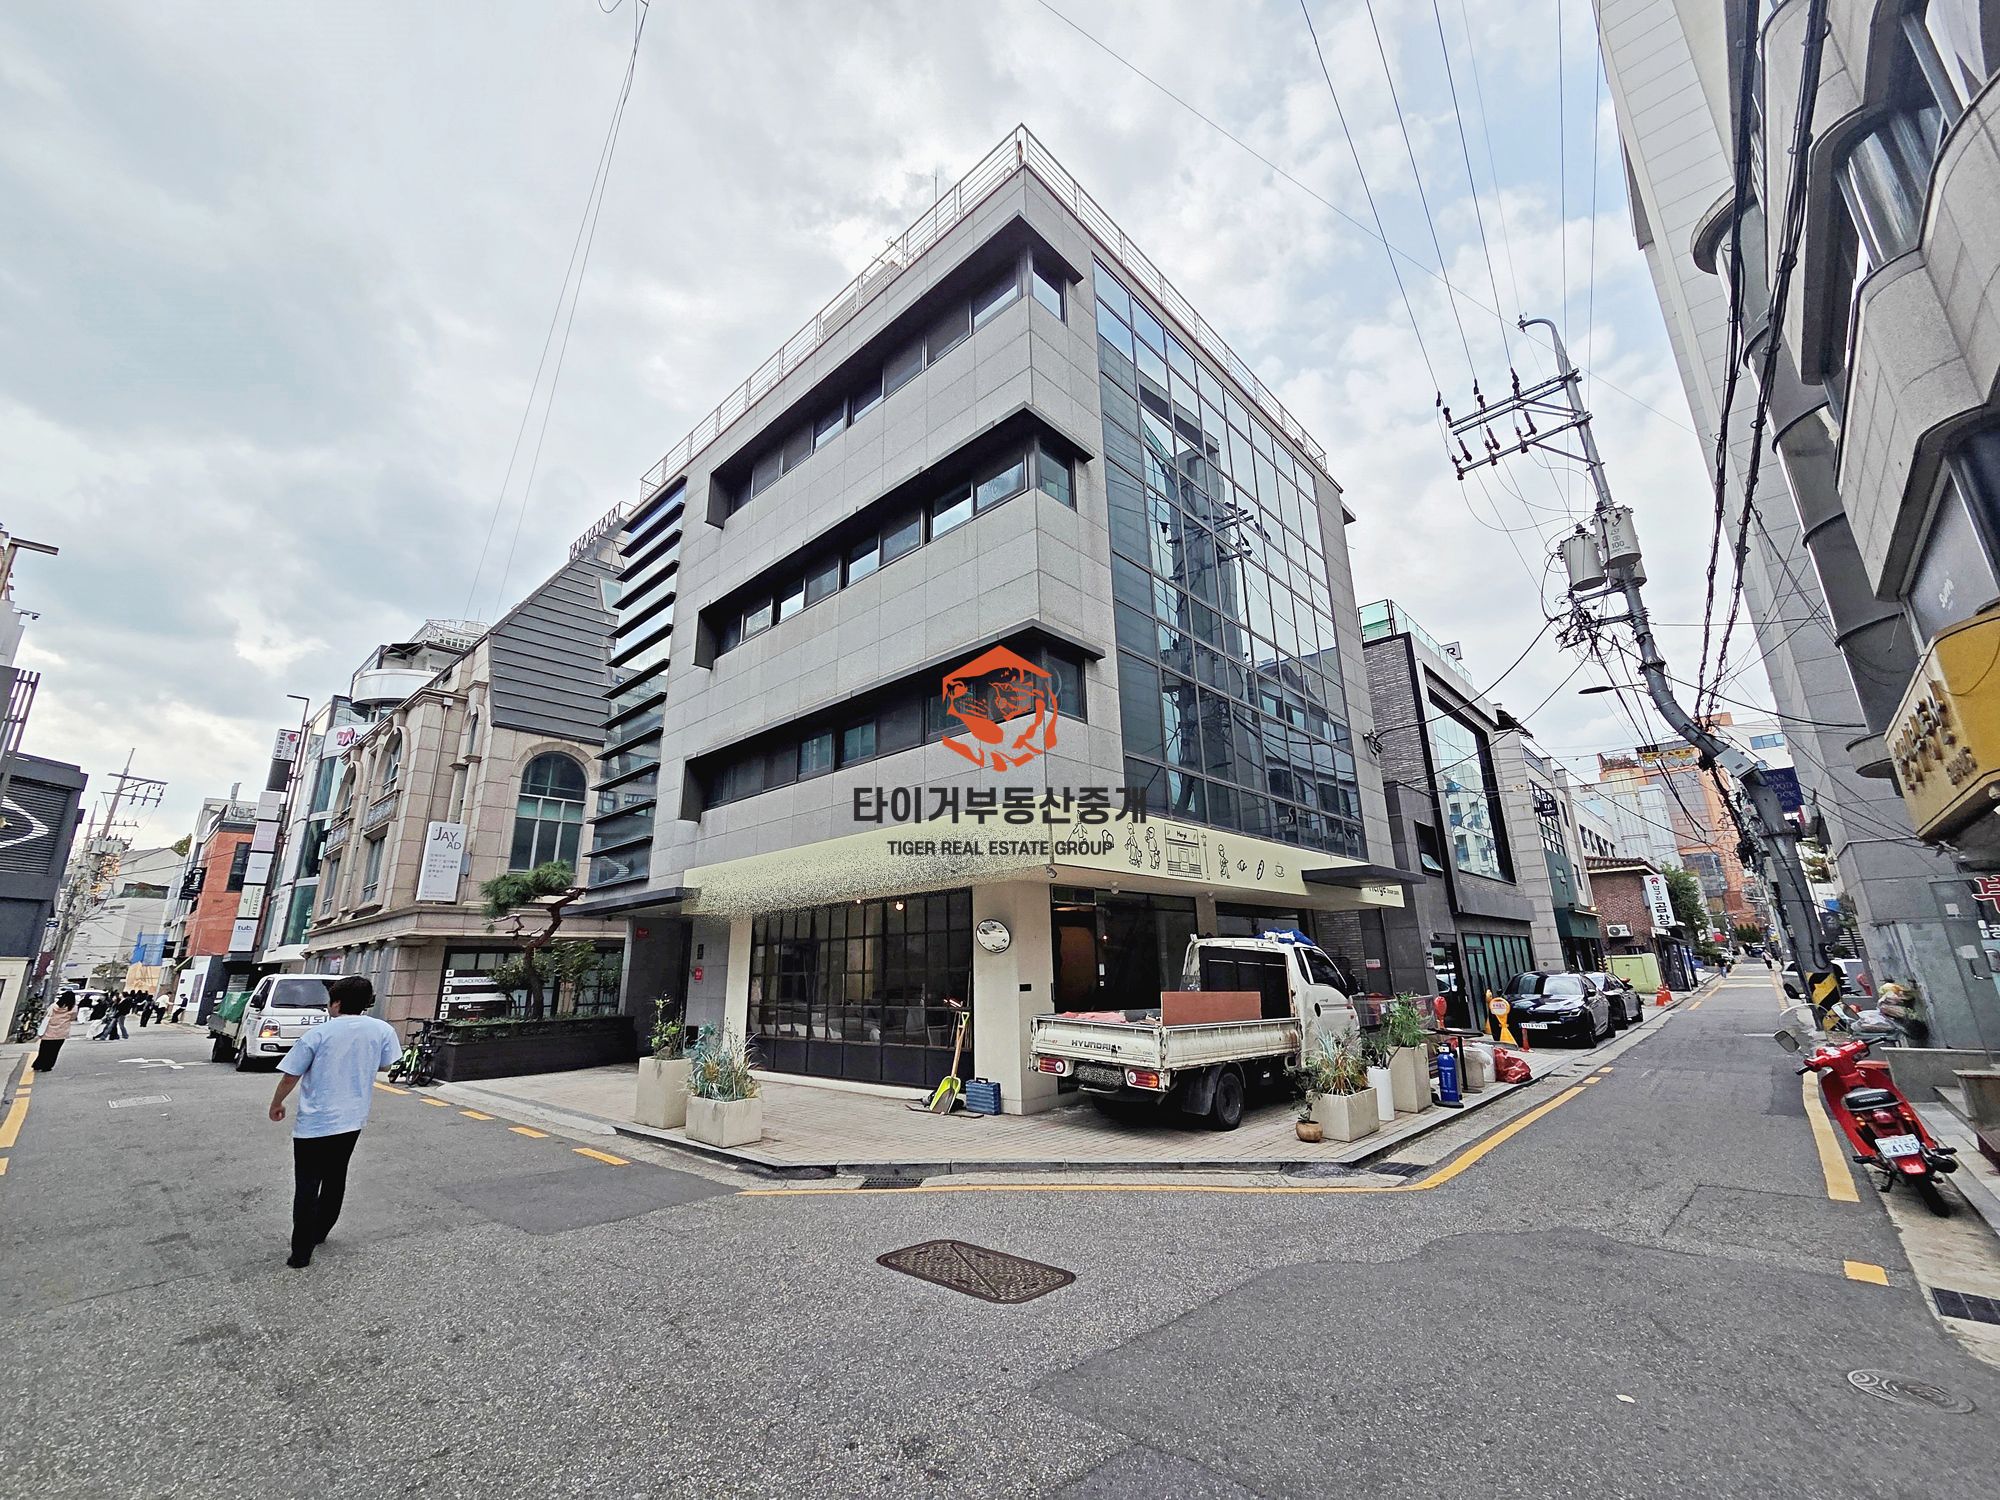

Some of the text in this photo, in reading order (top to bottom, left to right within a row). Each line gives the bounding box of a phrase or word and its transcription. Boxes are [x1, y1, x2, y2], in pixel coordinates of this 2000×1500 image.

[433, 826, 459, 842] JAY
[446, 841, 462, 850] AD
[1655, 902, 1671, 925] 곱창
[1071, 1039, 1111, 1051] HYUNDAI
